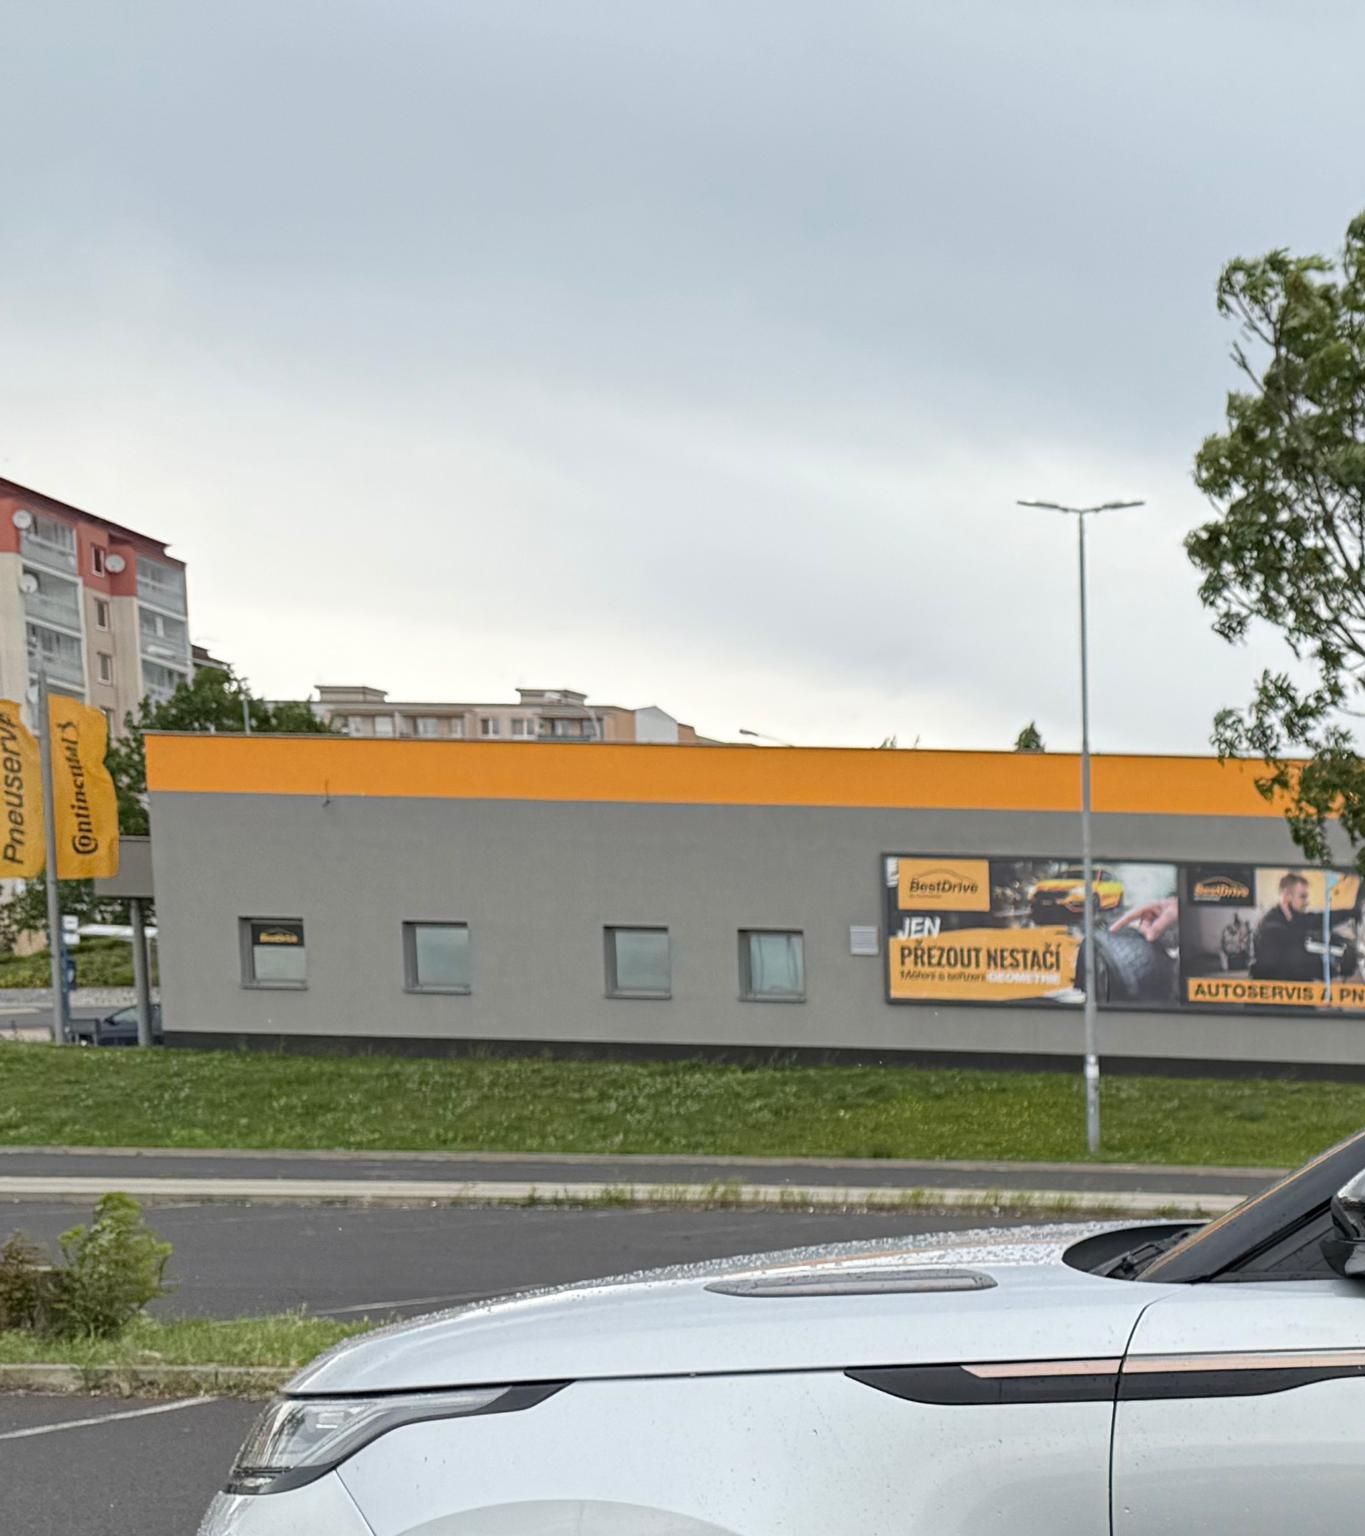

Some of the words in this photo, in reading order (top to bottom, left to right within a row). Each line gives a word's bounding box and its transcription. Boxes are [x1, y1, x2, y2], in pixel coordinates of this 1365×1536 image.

[909, 880, 979, 894] BestDrive
[897, 916, 942, 941] JEN
[900, 939, 983, 969] PŘEZOUT
[986, 942, 1062, 971] NESTAČÍ
[1194, 983, 1315, 1001] AUTOSERVIS
